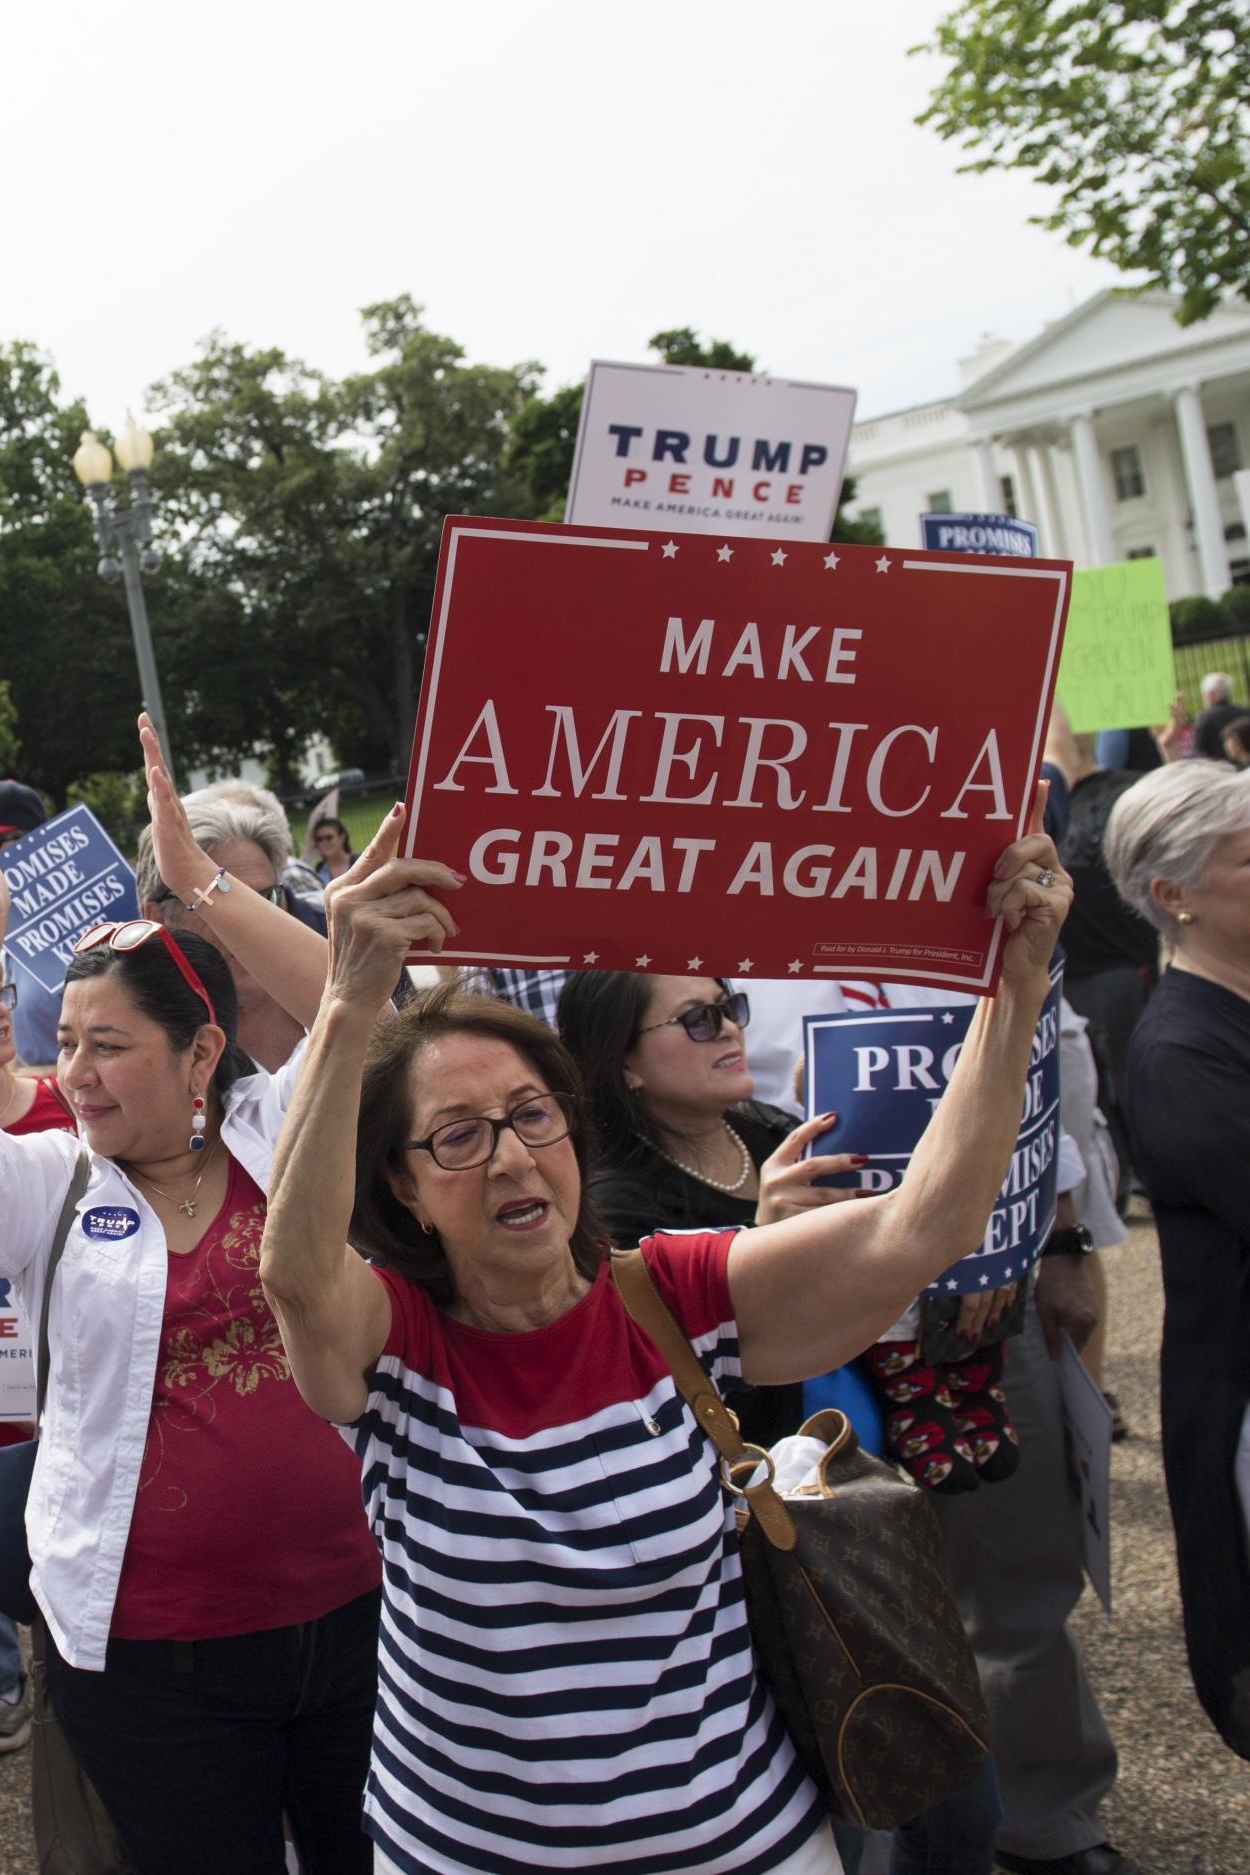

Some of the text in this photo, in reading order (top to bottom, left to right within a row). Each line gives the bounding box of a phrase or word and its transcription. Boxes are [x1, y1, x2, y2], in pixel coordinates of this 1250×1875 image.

[608, 424, 828, 475] TRUMP
[611, 496, 651, 511] MAKE
[656, 501, 721, 518] AMERICA
[624, 467, 804, 504] PENCE
[659, 617, 863, 684] MAKE
[433, 698, 1014, 820] AMERICA
[3, 825, 90, 894] OMISES
[11, 860, 86, 919] MADE
[468, 827, 966, 902] GREAT AGAIN
[16, 874, 126, 958] PROMISES
[889, 946, 912, 956] Trump
[962, 1188, 1039, 1260] EPT
